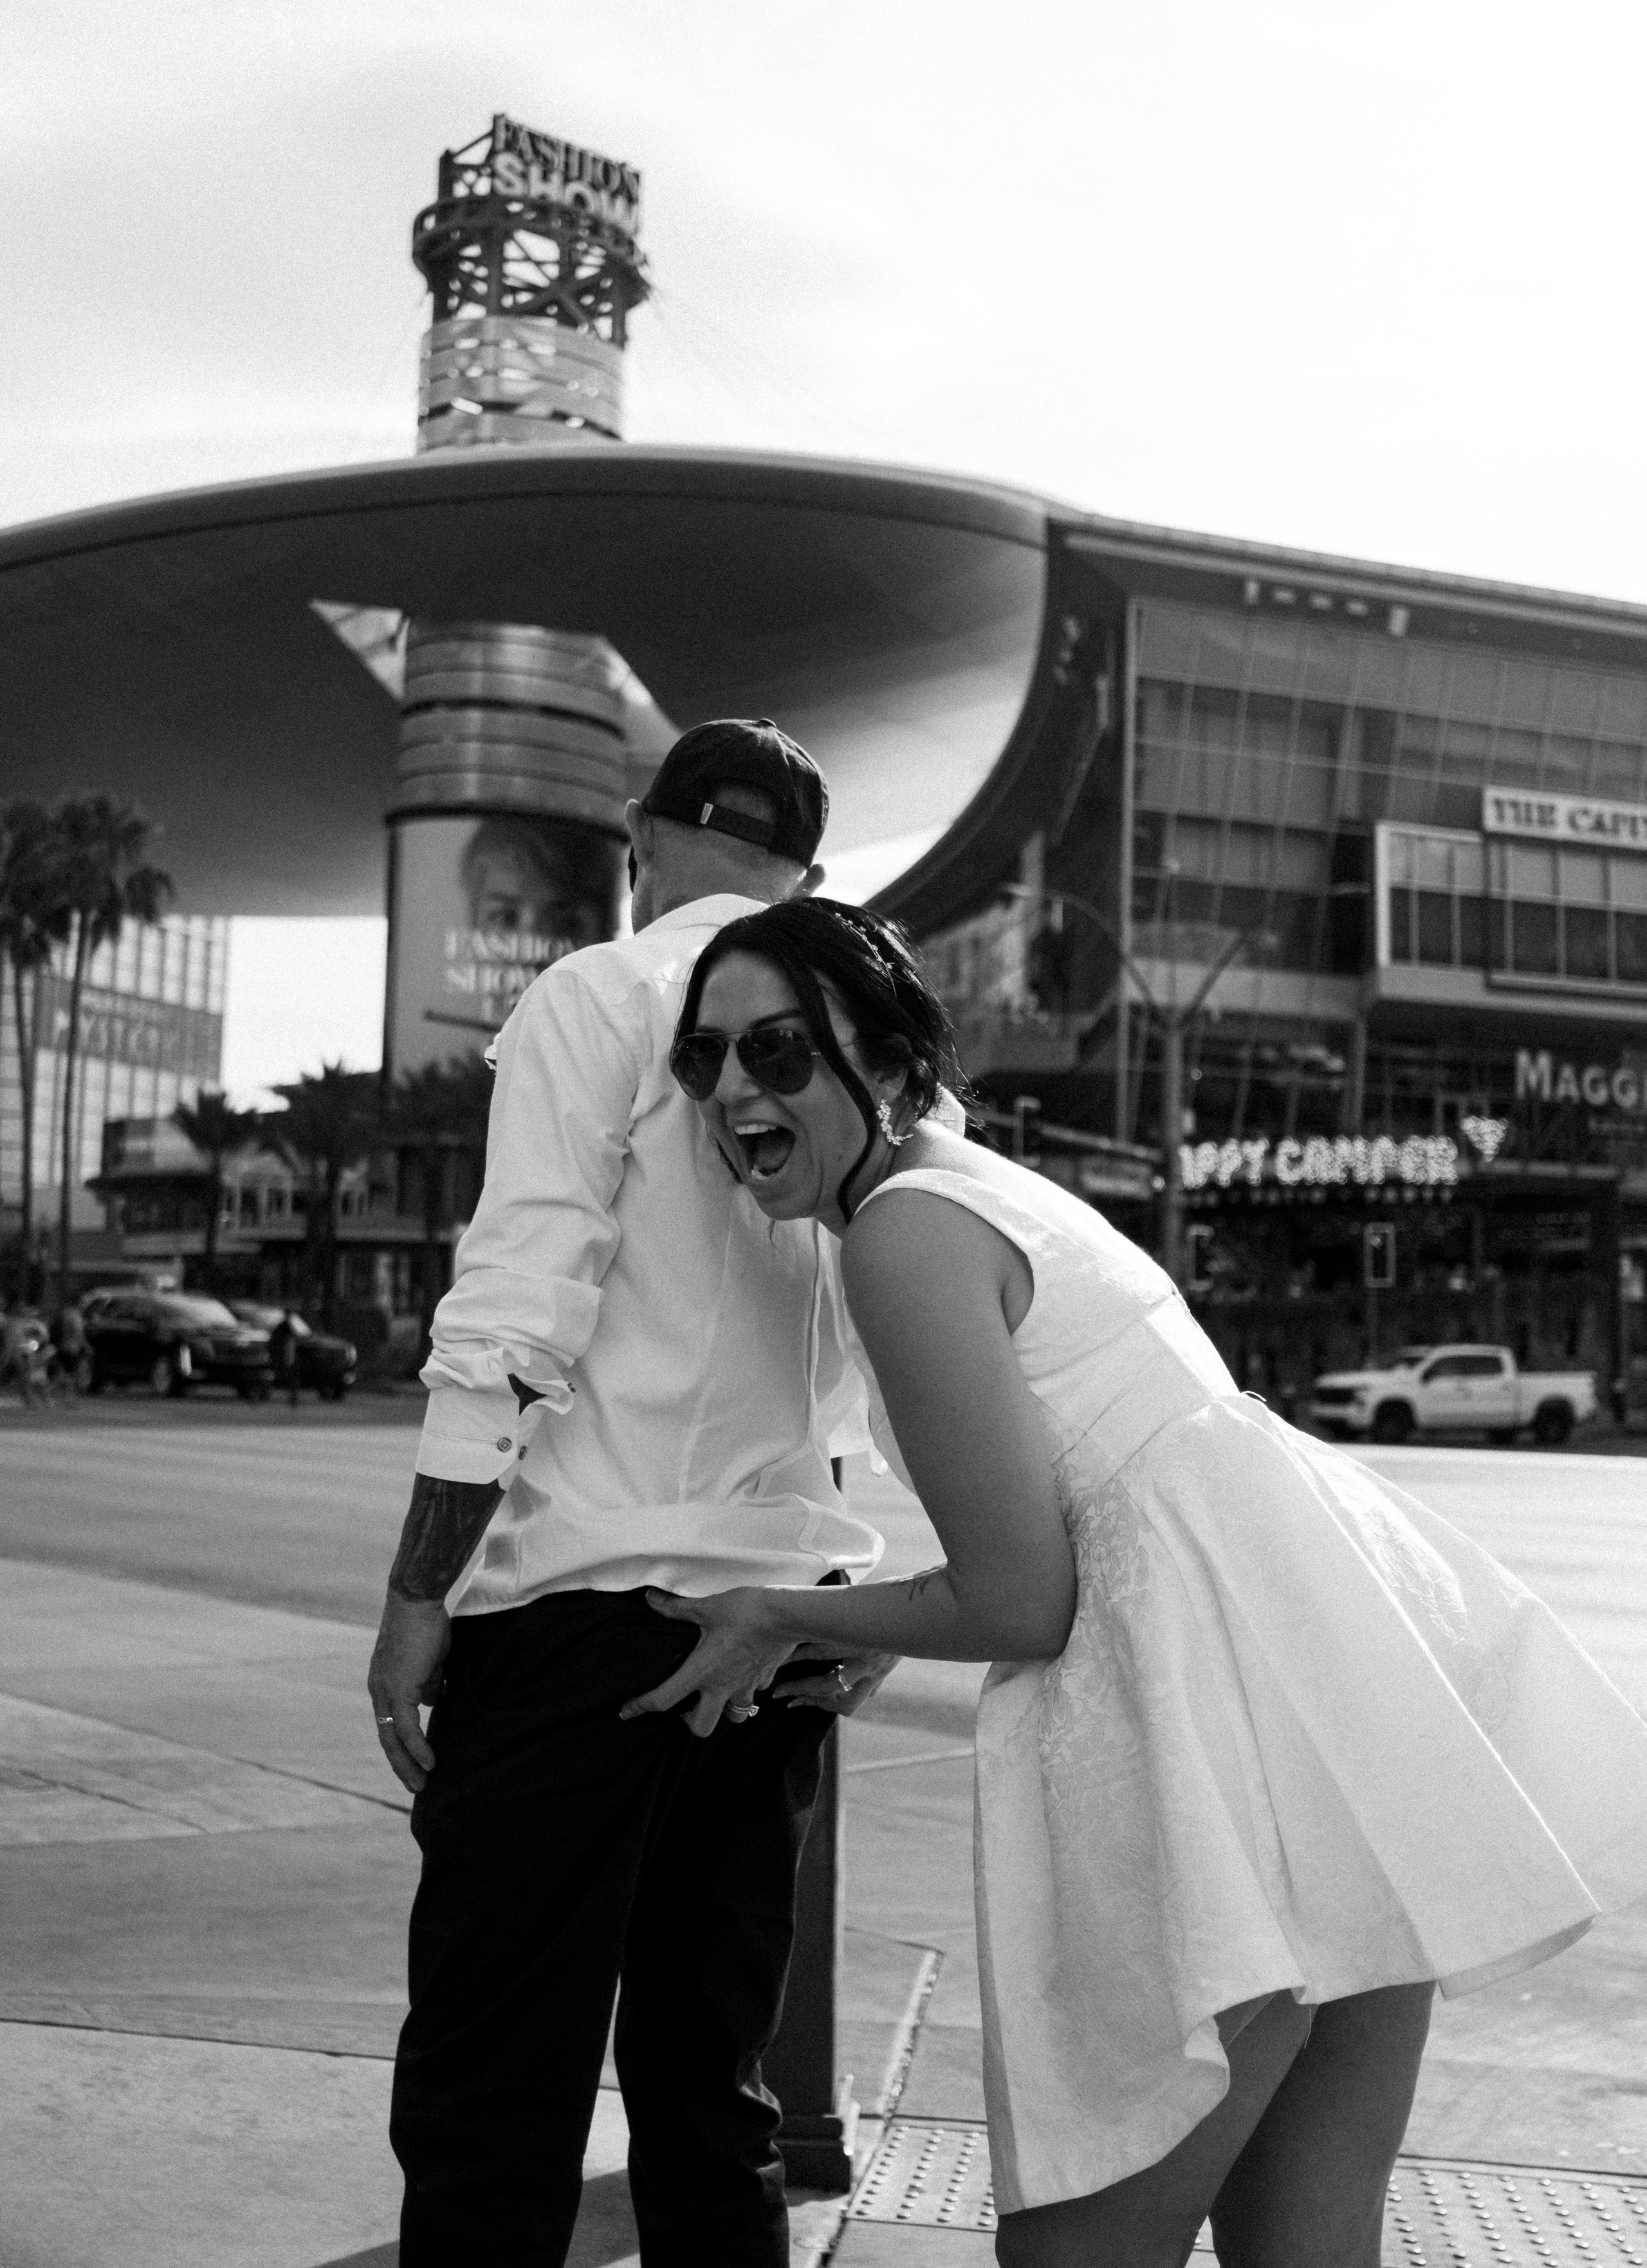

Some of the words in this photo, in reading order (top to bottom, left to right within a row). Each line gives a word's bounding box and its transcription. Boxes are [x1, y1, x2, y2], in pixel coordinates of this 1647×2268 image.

[492, 151, 639, 233] SHOW
[1493, 797, 1556, 828] THE
[1567, 806, 1647, 840] CAPI
[1275, 1134, 1458, 1186] CAMPER
